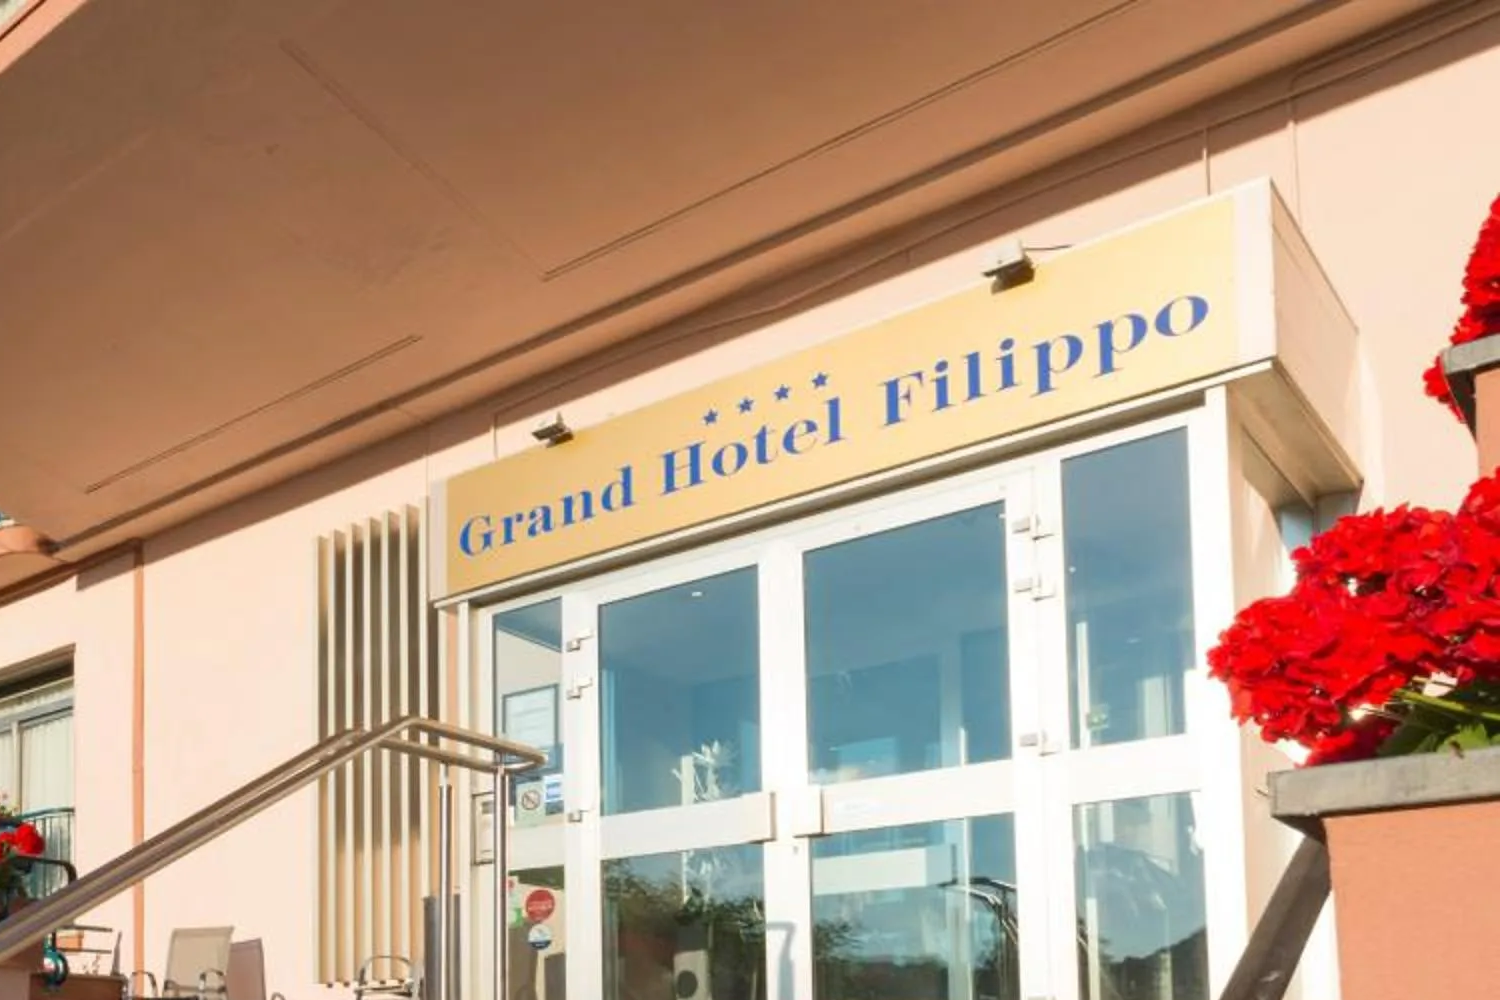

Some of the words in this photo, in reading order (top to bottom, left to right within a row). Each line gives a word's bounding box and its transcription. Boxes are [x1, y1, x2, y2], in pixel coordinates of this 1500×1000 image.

[458, 464, 637, 557] Grand
[659, 396, 845, 496] Hotel
[879, 294, 1211, 426] Filippo
